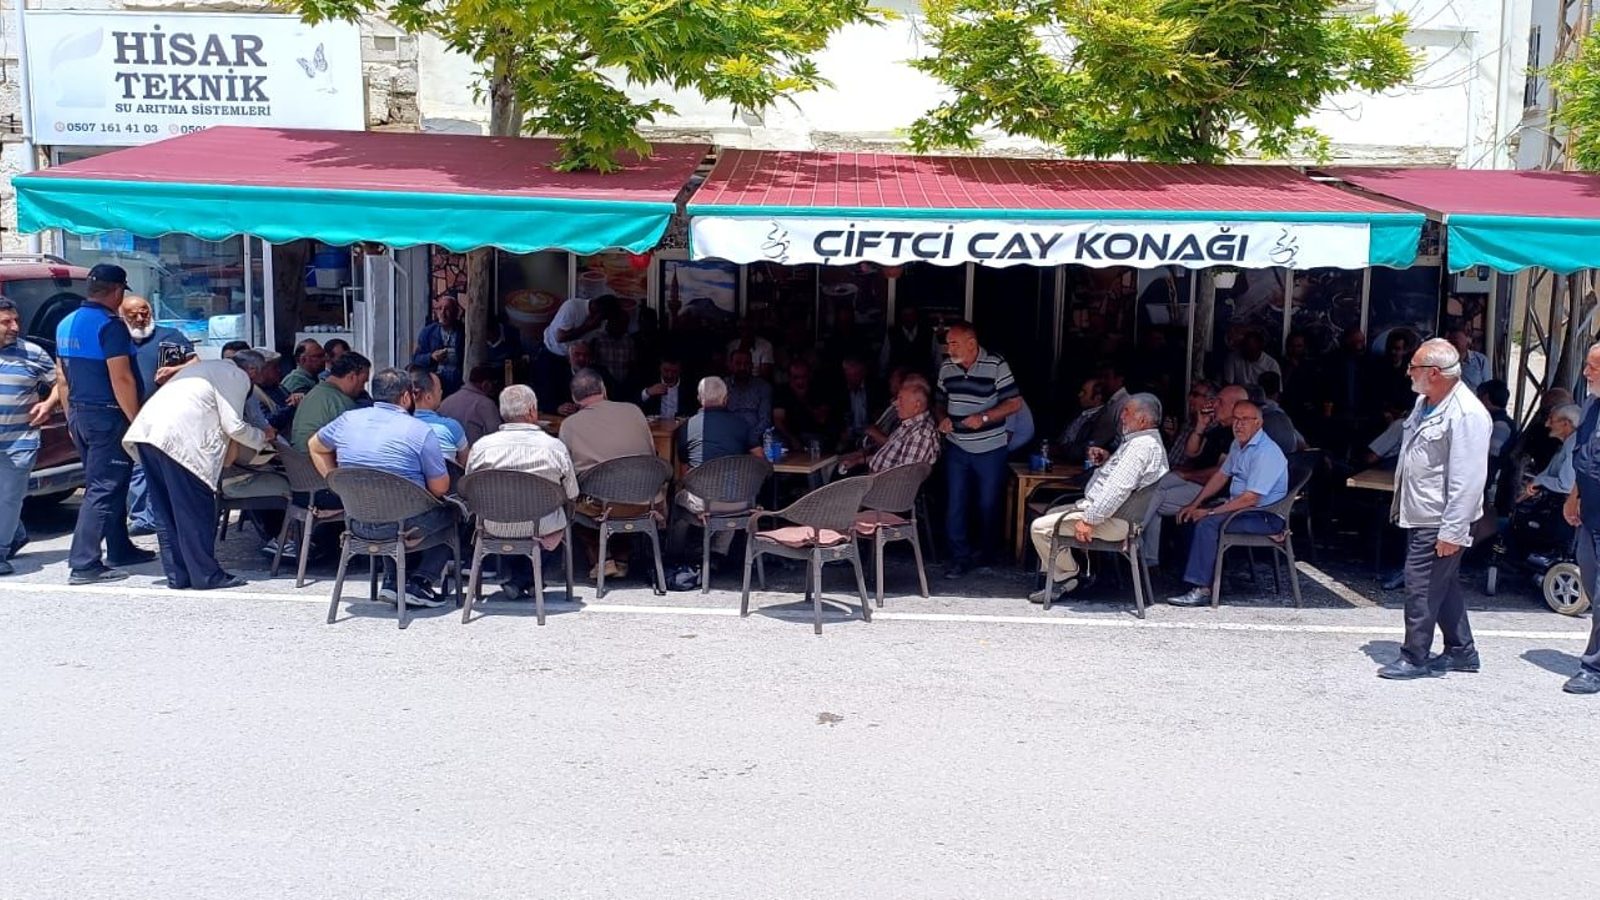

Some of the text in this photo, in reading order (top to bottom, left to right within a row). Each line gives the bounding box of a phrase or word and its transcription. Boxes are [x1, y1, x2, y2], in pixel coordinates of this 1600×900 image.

[112, 24, 267, 66] HİSAR
[115, 68, 270, 101] TEKNİK
[115, 103, 271, 116] SU ARITMA SİSTEMLERİ
[66, 122, 158, 133] 0507 161 41 03
[967, 232, 1064, 264] ÇAY
[1075, 227, 1249, 261] KONAĞI
